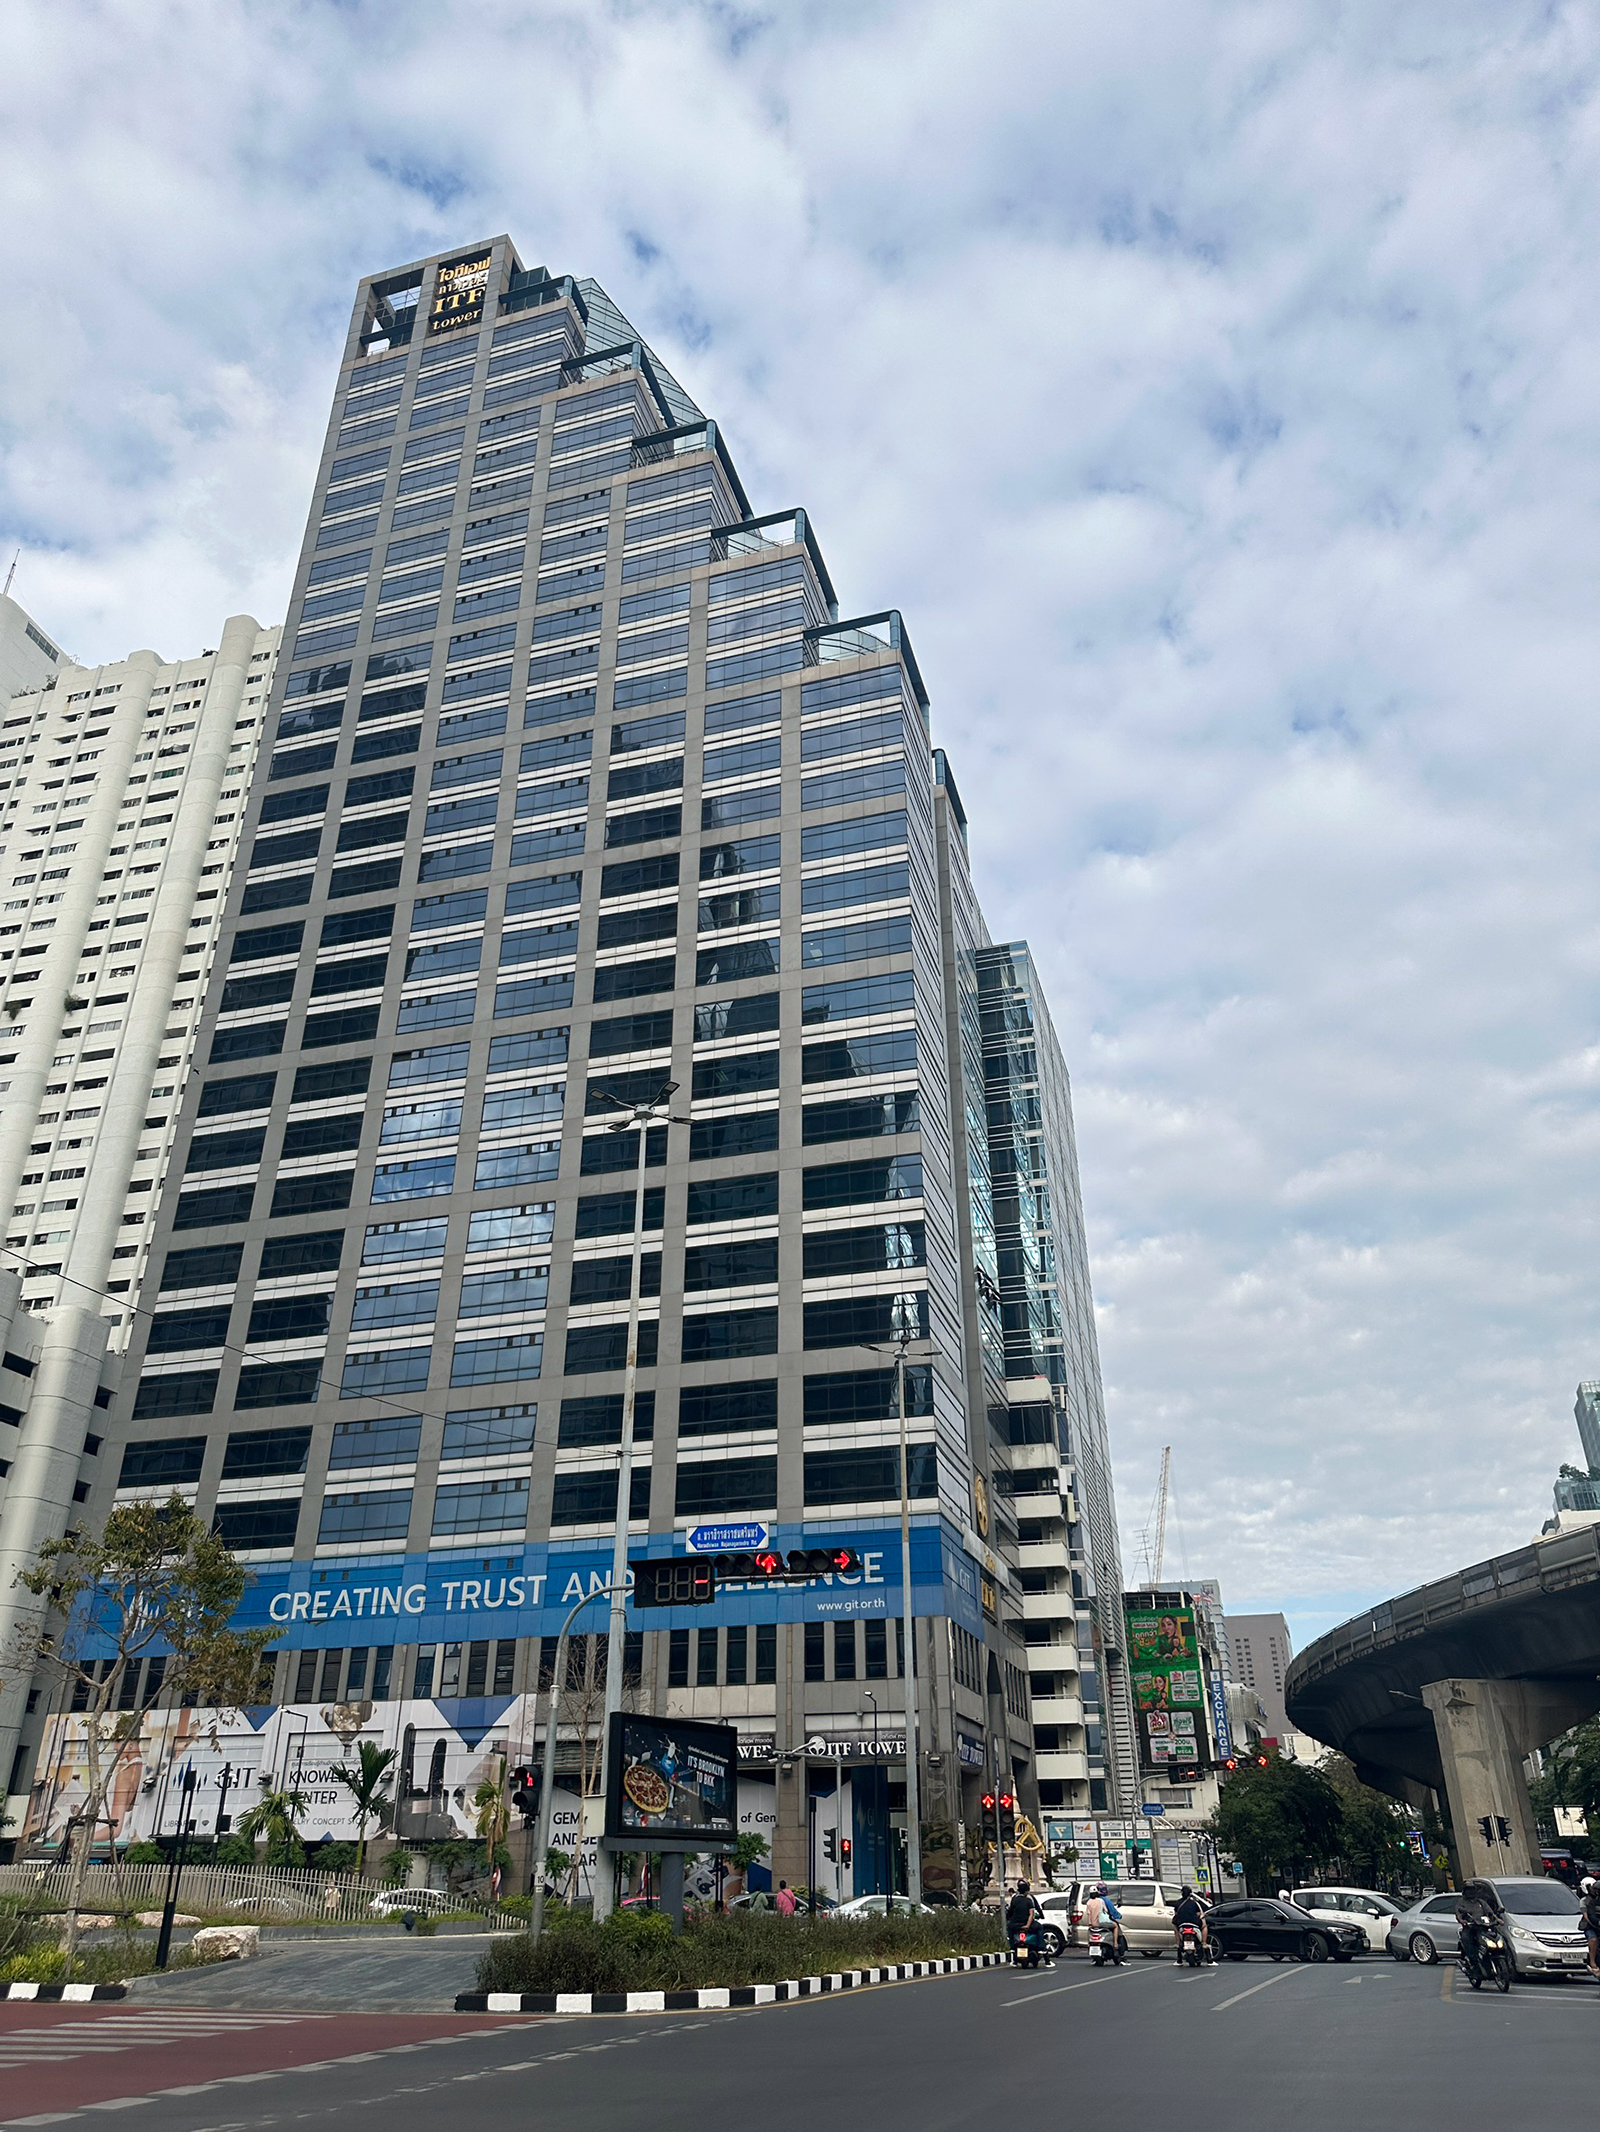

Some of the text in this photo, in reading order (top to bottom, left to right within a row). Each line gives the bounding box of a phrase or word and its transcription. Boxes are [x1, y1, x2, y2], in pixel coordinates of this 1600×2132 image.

[438, 256, 491, 283] ไอทีเอฟ
[433, 286, 486, 315] ITF
[432, 308, 482, 330] tower
[269, 1583, 427, 1622] CREATING
[441, 1574, 548, 1611] TRUST
[816, 1597, 886, 1613] www.git.or.th
[1213, 1683, 1229, 1756] EXCHANGE
[827, 1741, 908, 1756] ITF TOWE
[312, 1817, 346, 1826] CONCEPT
[740, 1813, 751, 1823] of
[537, 1876, 545, 1884] 10
